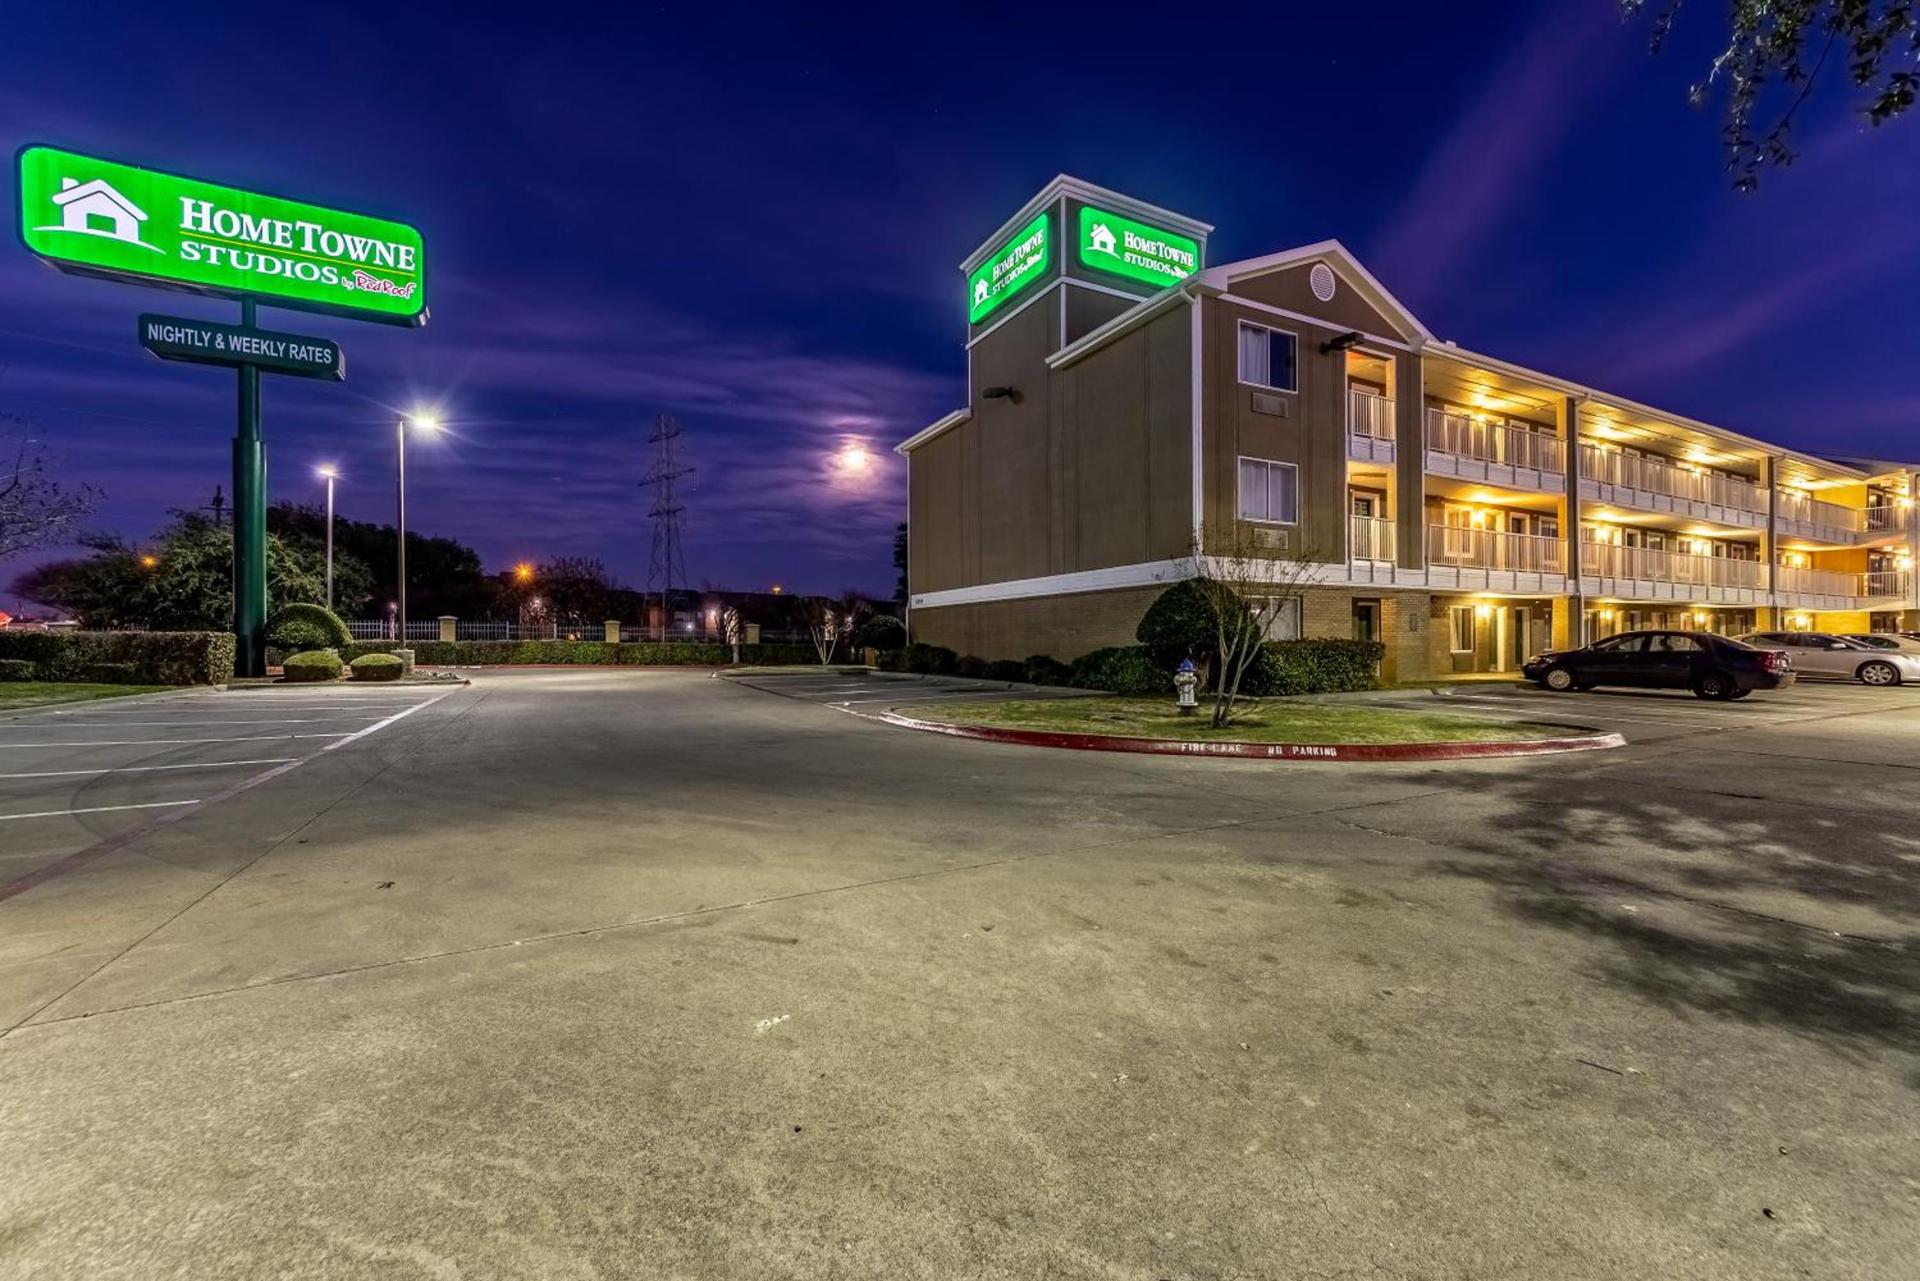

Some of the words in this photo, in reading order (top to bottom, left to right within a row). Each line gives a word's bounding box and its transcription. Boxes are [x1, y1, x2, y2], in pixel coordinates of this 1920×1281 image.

[180, 240, 339, 286] STUDIOS
[993, 263, 1026, 295] STUDIOS
[1124, 252, 1171, 274] STUDIOS
[148, 323, 211, 348] NIGHTLY
[215, 332, 226, 350] &
[229, 335, 286, 359] WEEKLY
[289, 342, 332, 365] RATES
[1181, 743, 1208, 752] FIRE
[1212, 744, 1242, 753] LANE
[1268, 746, 1282, 755] NO
[1292, 746, 1337, 757] PARKING
